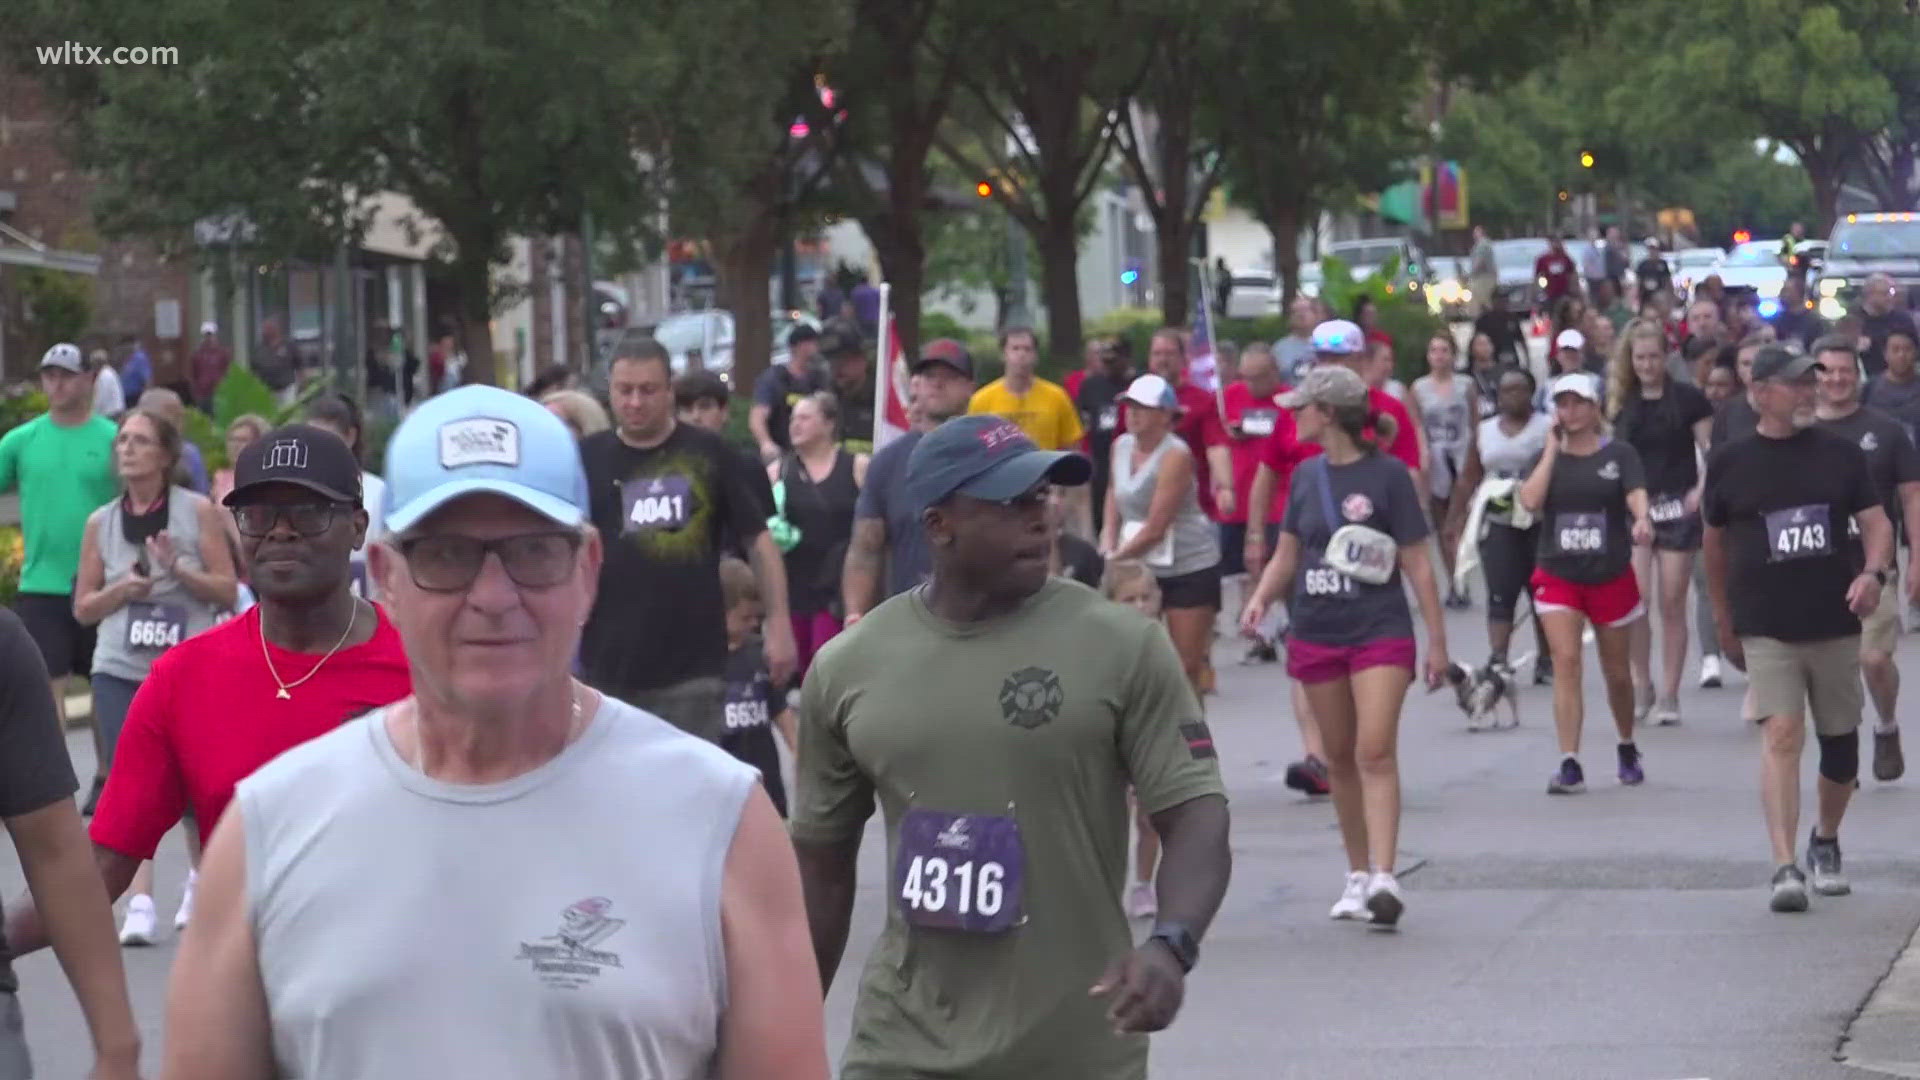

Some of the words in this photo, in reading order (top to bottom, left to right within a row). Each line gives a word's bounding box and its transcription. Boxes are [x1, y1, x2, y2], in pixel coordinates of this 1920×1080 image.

[630, 494, 683, 525] 4041
[1777, 522, 1826, 554] 4743
[130, 620, 180, 646] 6654
[724, 701, 769, 729] 6634
[902, 854, 1005, 916] 4316
